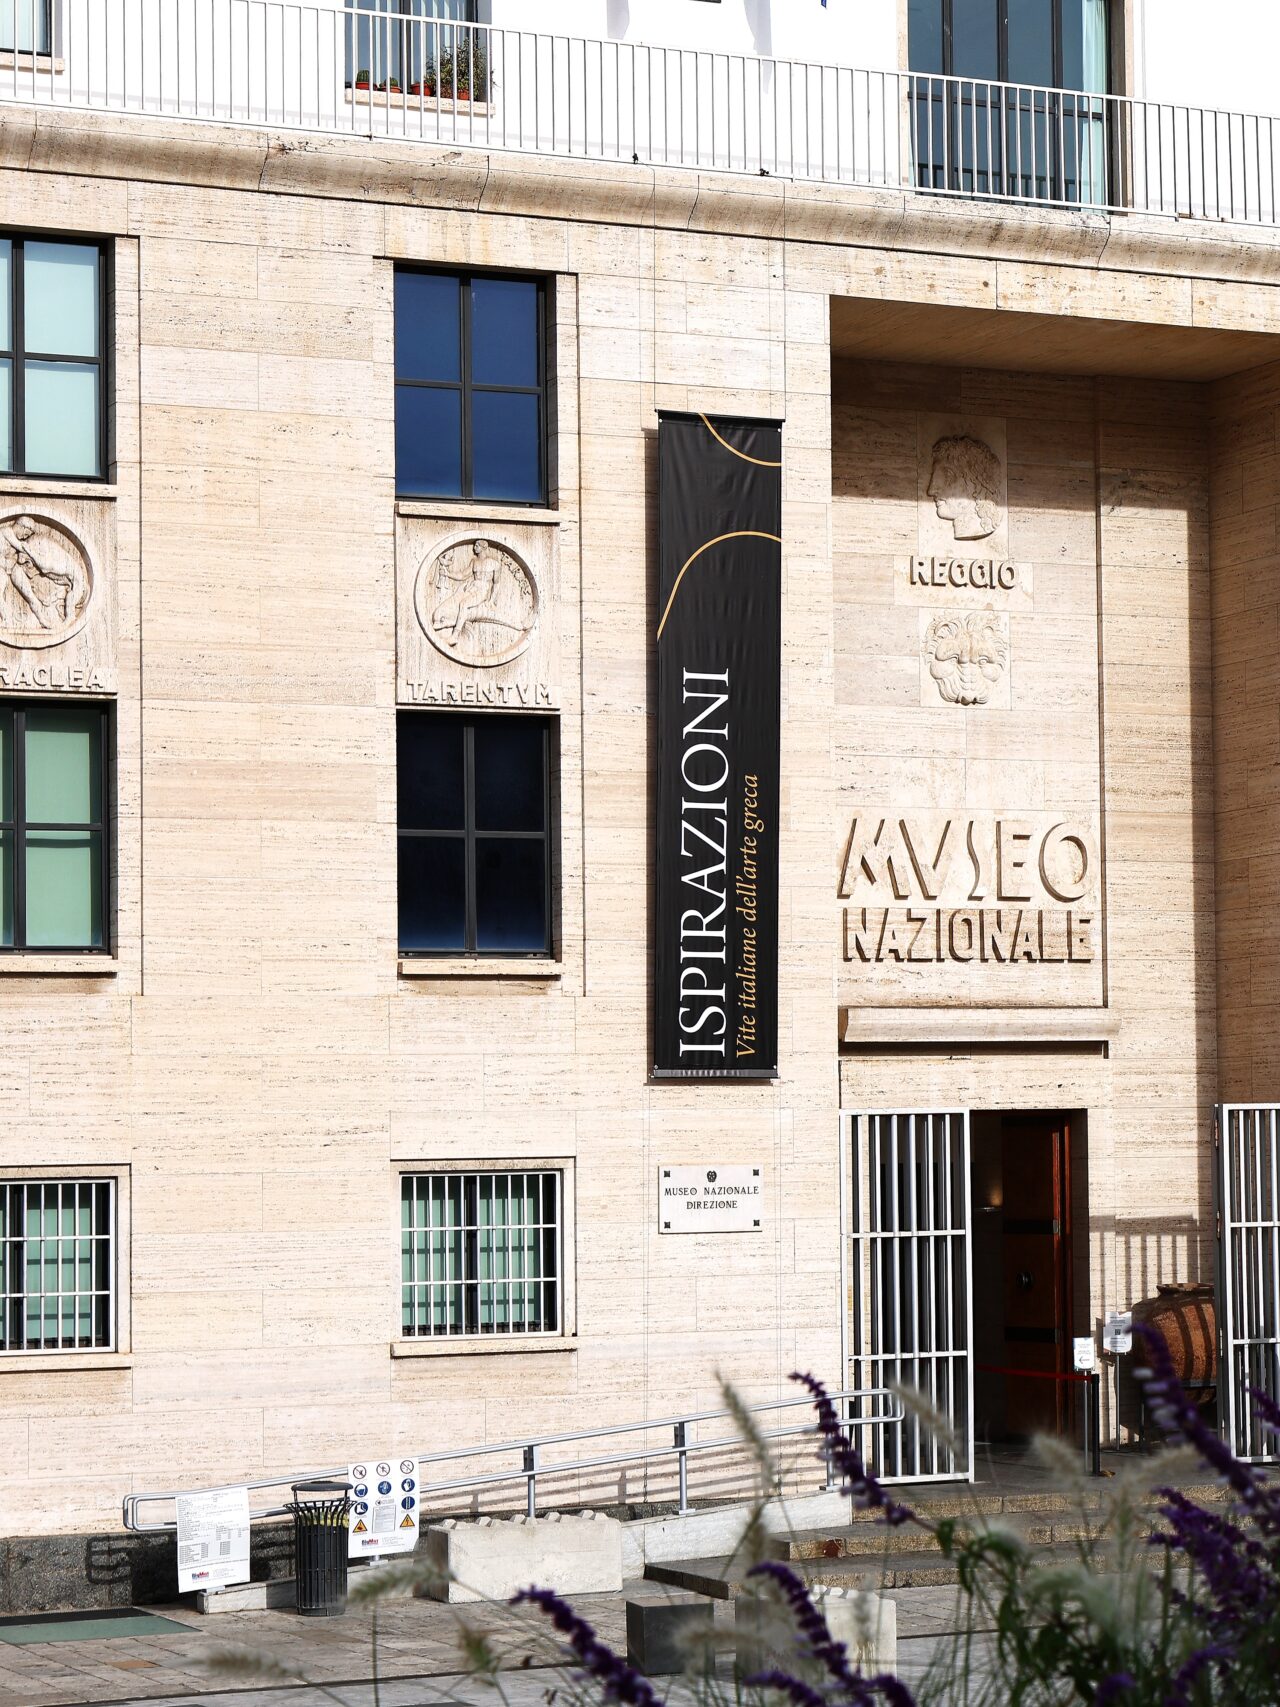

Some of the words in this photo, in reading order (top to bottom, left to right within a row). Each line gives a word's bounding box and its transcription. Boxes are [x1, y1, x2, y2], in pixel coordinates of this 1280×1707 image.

[909, 555, 1016, 590] REGGIO
[406, 680, 552, 705] TARENTVM
[744, 774, 766, 833] greca
[678, 666, 729, 1057] ISPIRAZIONI
[735, 836, 758, 921] dell'arte
[836, 818, 1095, 903] MVSEO
[842, 907, 1093, 963] NAZIONALE
[735, 927, 757, 1008] italiane
[736, 1017, 757, 1058] Vite
[664, 1187, 698, 1196] MUSEO
[703, 1186, 760, 1196] NAZIONALE
[686, 1200, 738, 1210] DIREZIONE
